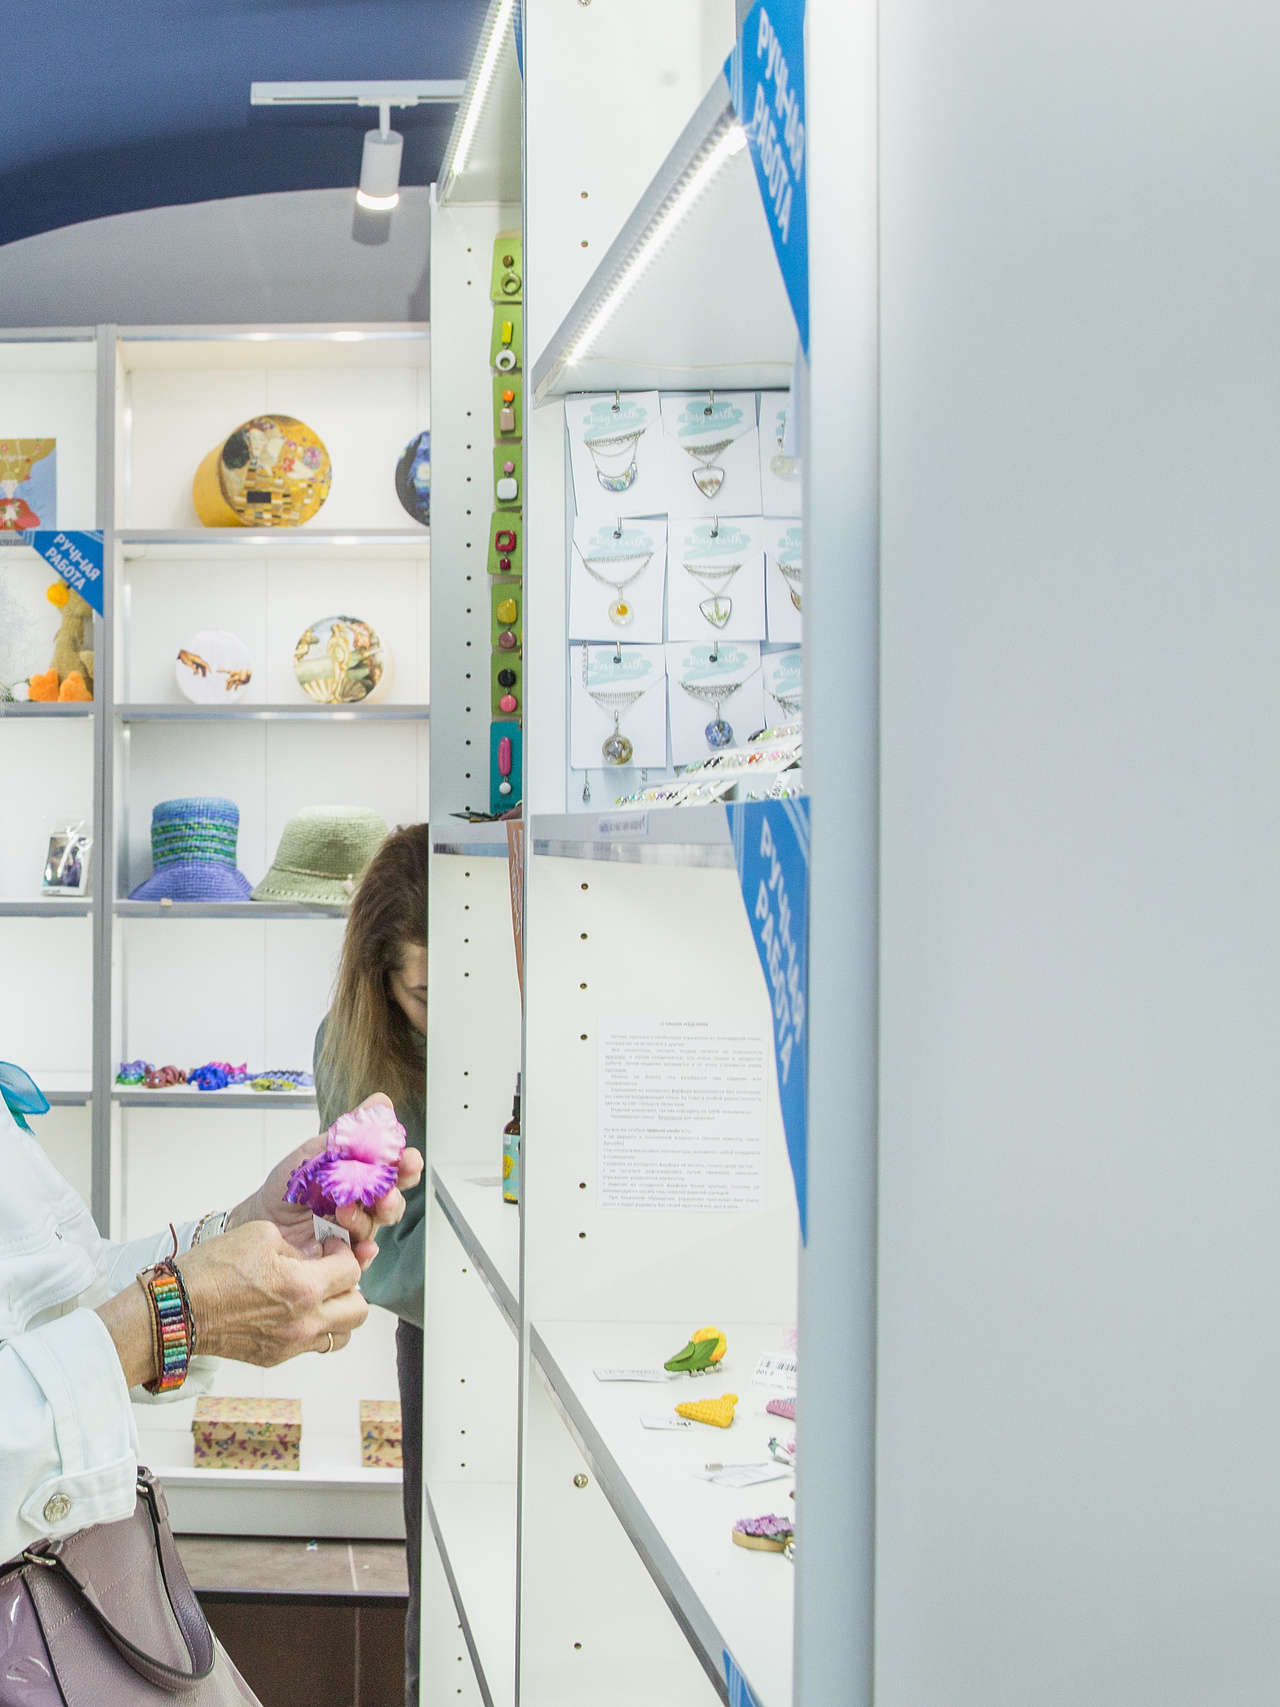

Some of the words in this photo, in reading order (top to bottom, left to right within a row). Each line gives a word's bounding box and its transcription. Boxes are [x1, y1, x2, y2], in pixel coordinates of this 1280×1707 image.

[753, 81, 793, 244] РАБОТА
[757, 7, 805, 182] РУЧНАЯ
[45, 546, 86, 590] РАБОТА
[53, 533, 100, 581] РУЧНАЯ
[755, 879, 793, 1085] РАБОТА
[760, 815, 805, 1044] РУЧНАЯ
